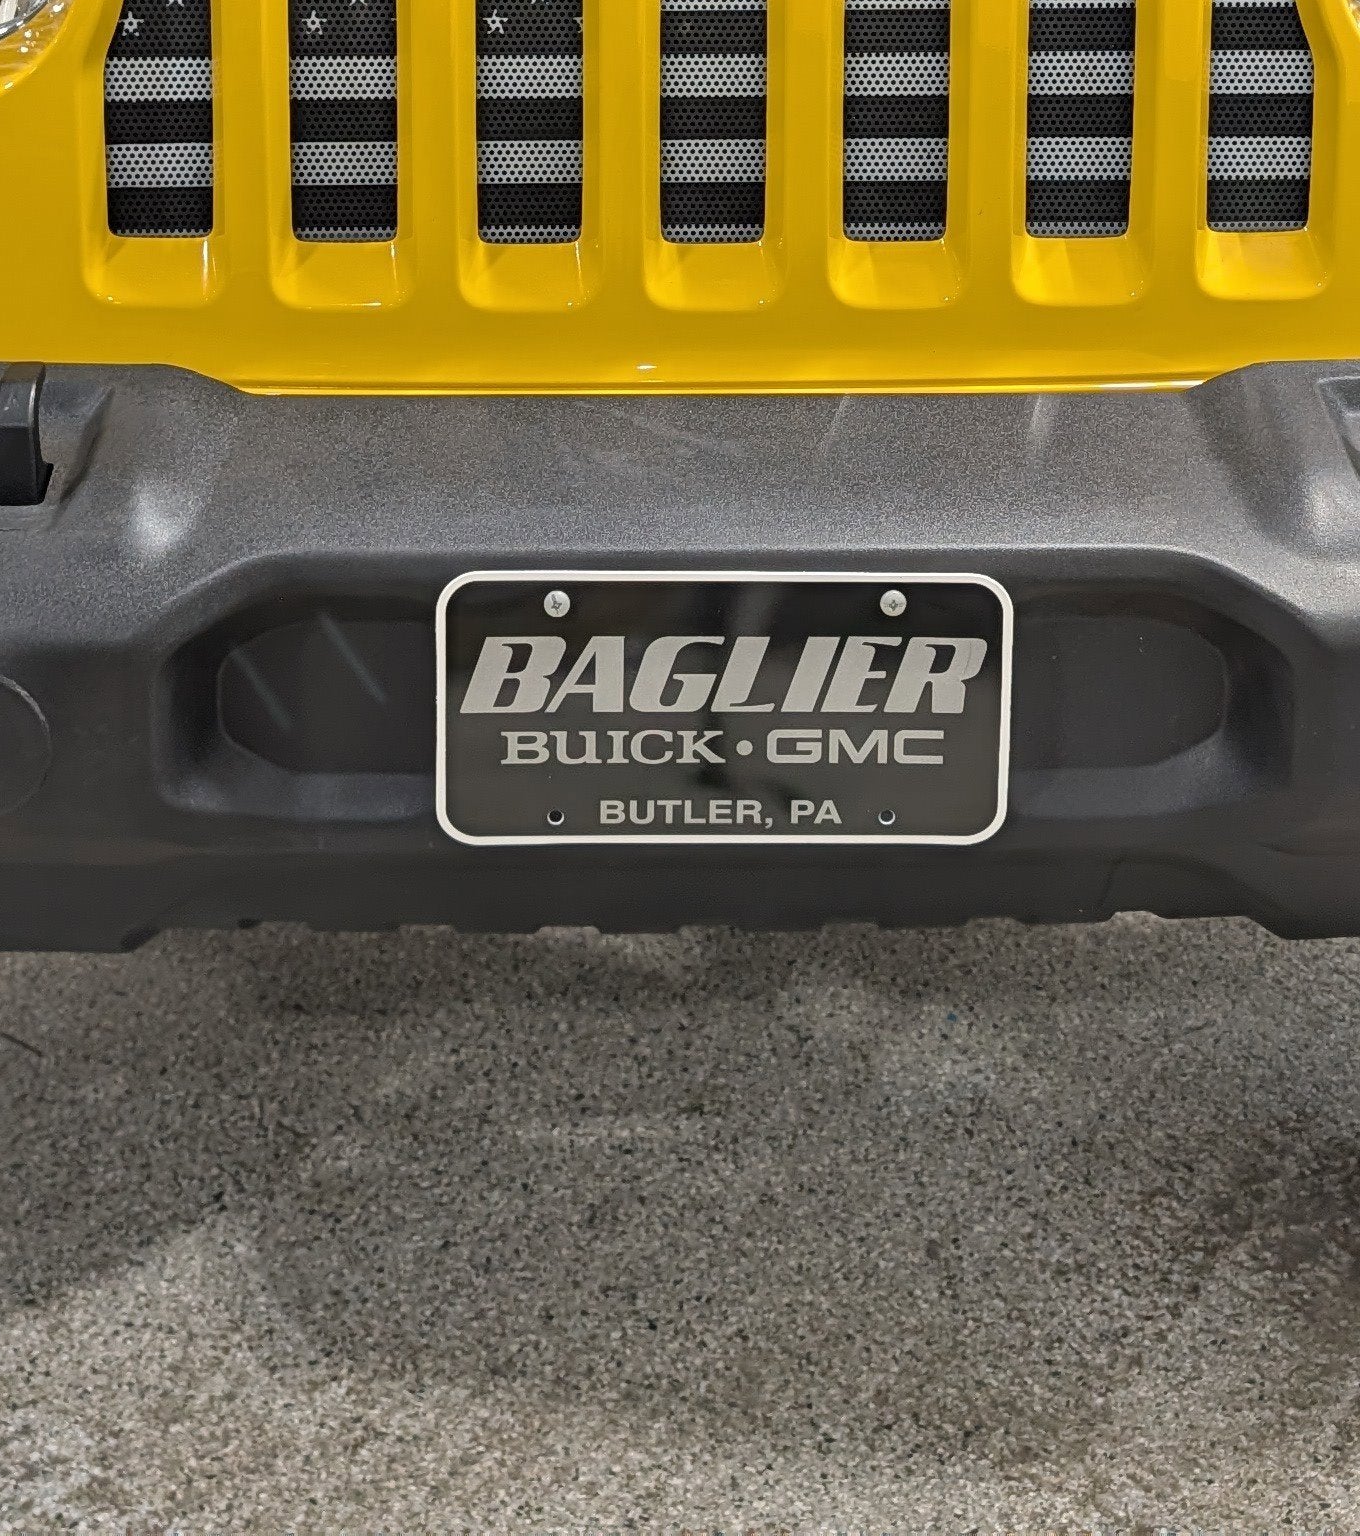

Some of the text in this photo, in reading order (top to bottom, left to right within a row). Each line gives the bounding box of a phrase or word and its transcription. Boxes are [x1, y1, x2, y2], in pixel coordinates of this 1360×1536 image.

[459, 635, 988, 714] BAGLIER
[500, 729, 945, 765] BUICK GMC
[599, 800, 843, 828] BUTLER, PA
